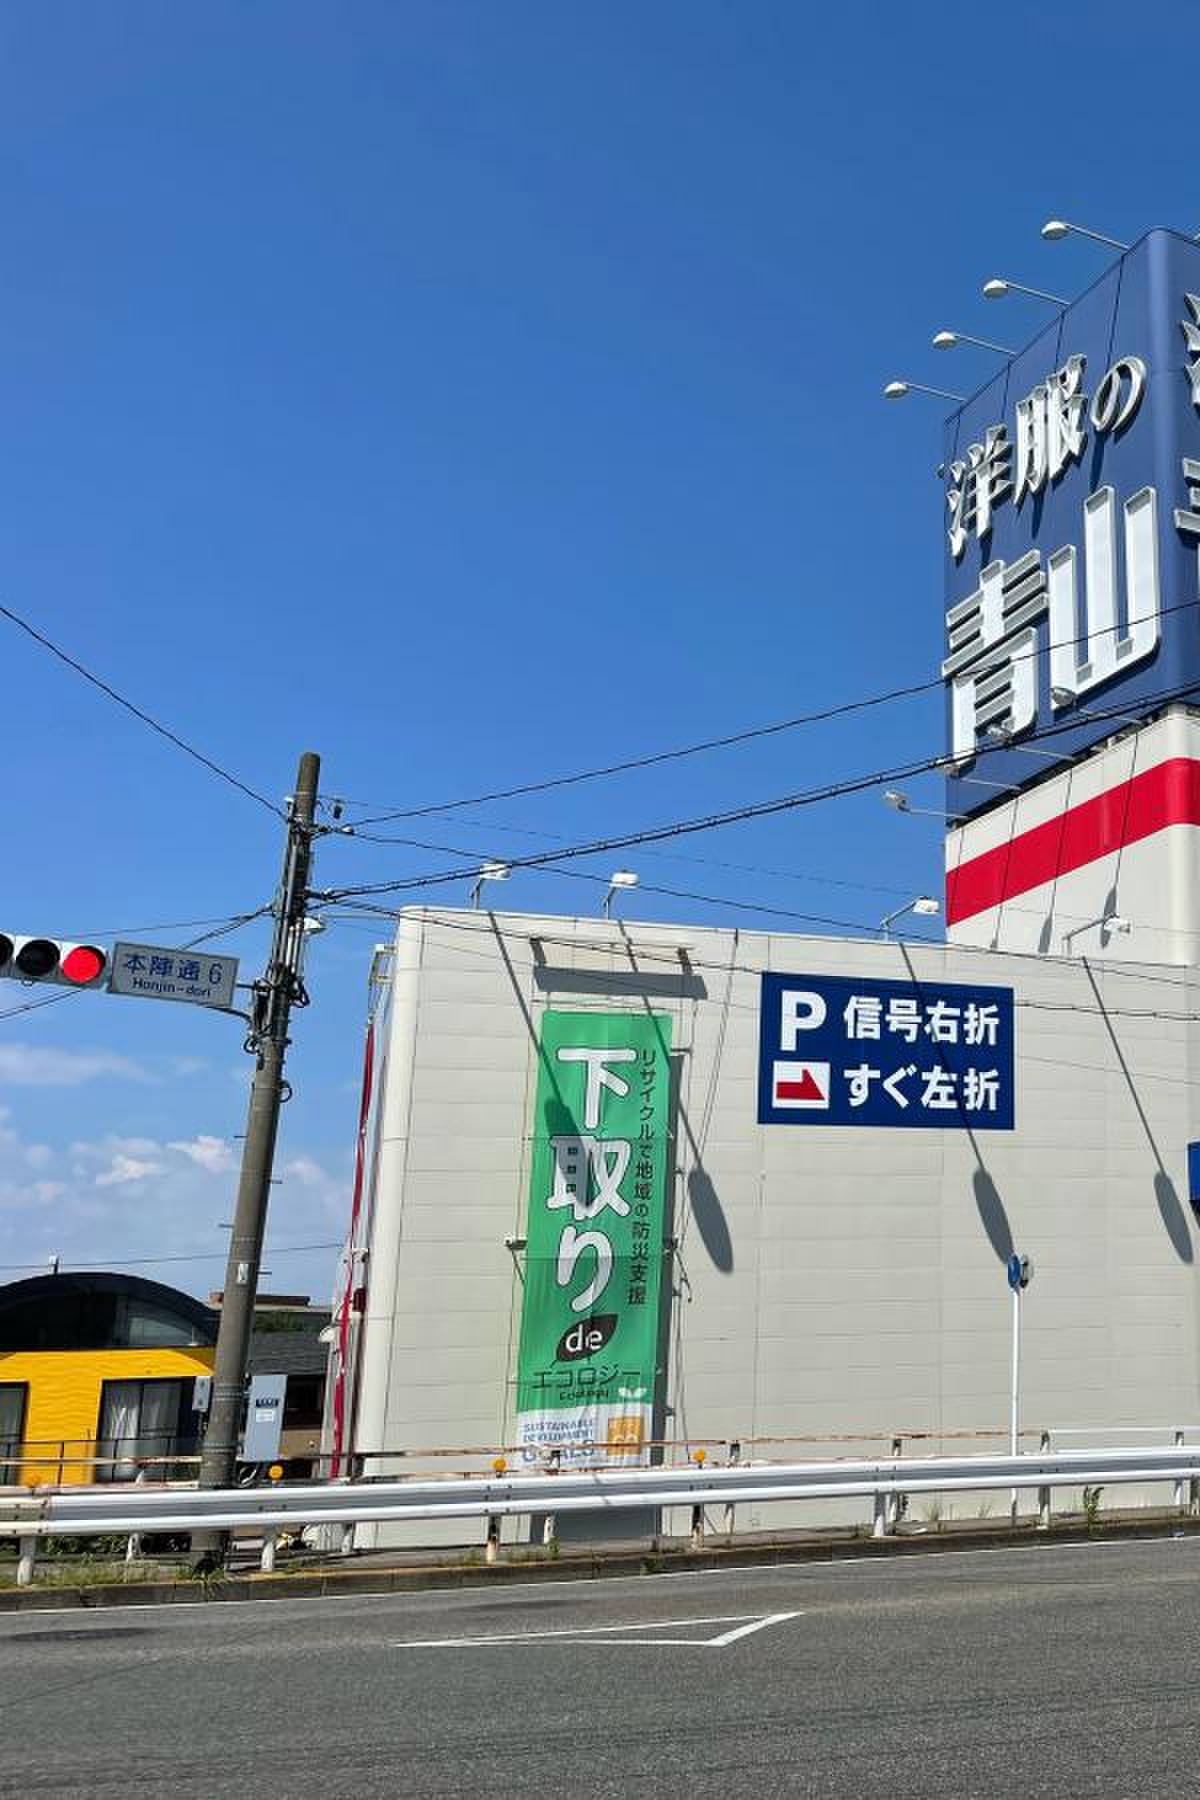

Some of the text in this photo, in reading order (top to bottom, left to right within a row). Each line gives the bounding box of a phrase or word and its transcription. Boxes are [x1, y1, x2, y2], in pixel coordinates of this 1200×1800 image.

[937, 353, 1147, 559] 洋服の
[942, 485, 1159, 774] 青山
[132, 977, 211, 998] Honjin-dori
[780, 990, 827, 1051] P
[843, 995, 1000, 1046] 信号右折
[843, 1063, 1000, 1111] すぐ左折
[546, 1047, 638, 1312] 下取り
[565, 1324, 603, 1351] de
[531, 1364, 641, 1389] エコロジー
